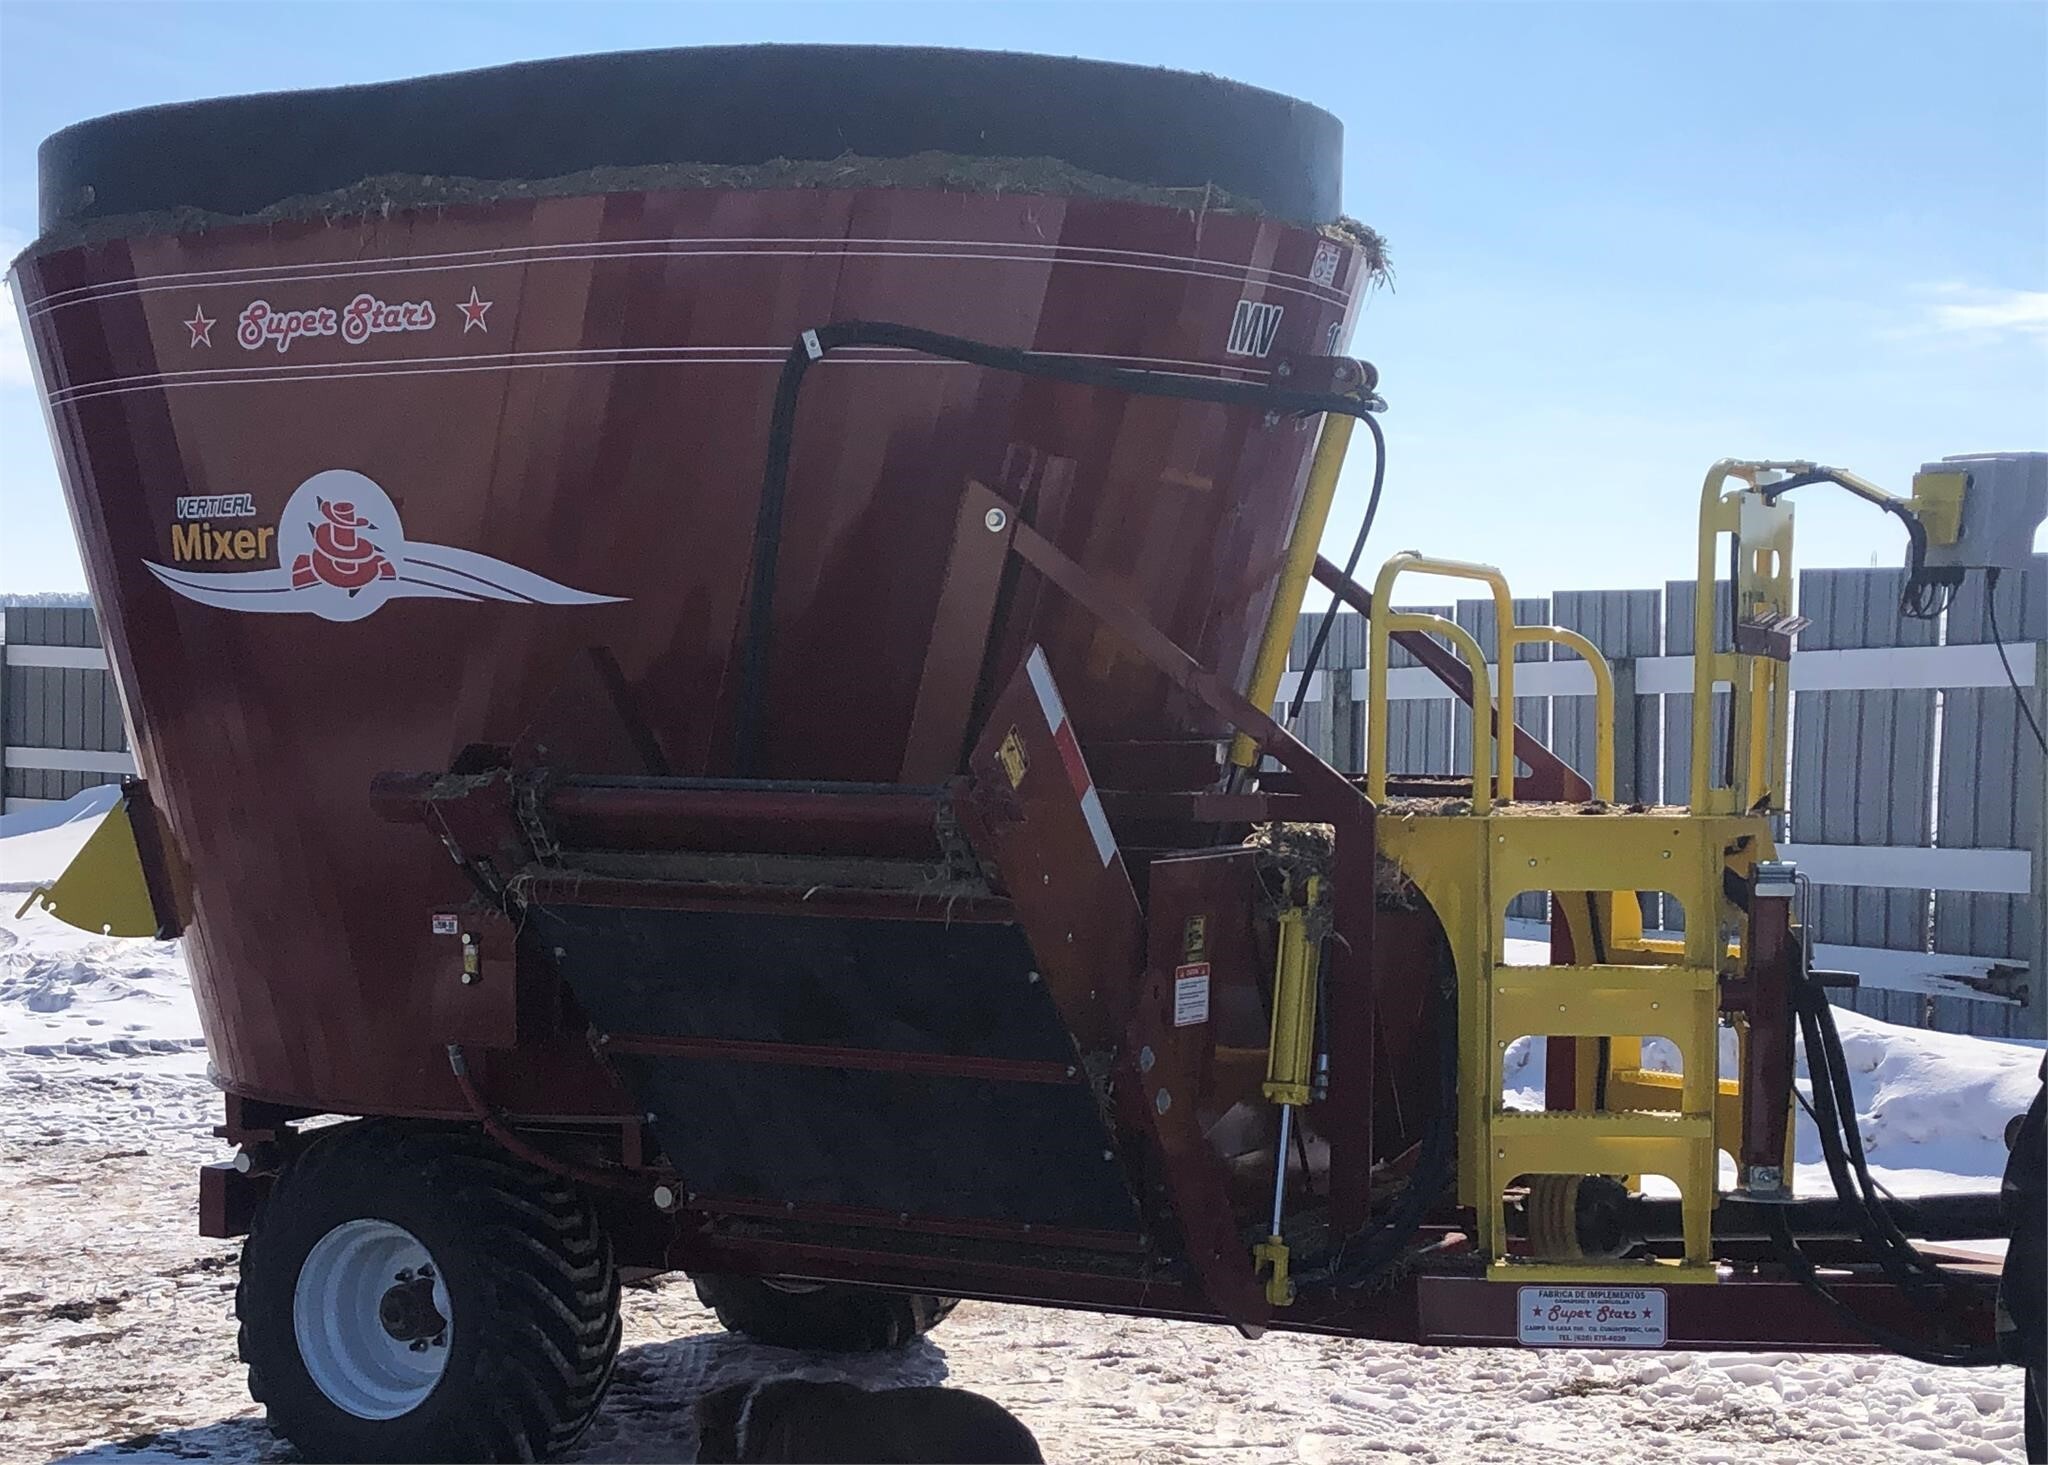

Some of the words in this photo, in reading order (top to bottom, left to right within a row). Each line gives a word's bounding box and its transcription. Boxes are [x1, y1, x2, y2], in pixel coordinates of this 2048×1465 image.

[238, 300, 337, 353] Super
[342, 294, 435, 344] Stars
[1227, 300, 1284, 358] MV
[177, 494, 256, 519] VERTICAL
[172, 522, 274, 562] Mixer
[1539, 1290, 1573, 1298] FABRICA
[1575, 1290, 1585, 1298] DE
[1587, 1291, 1646, 1299] IMPLEMENTOS
[1548, 1305, 1592, 1324] Super
[1596, 1305, 1637, 1322] Stars
